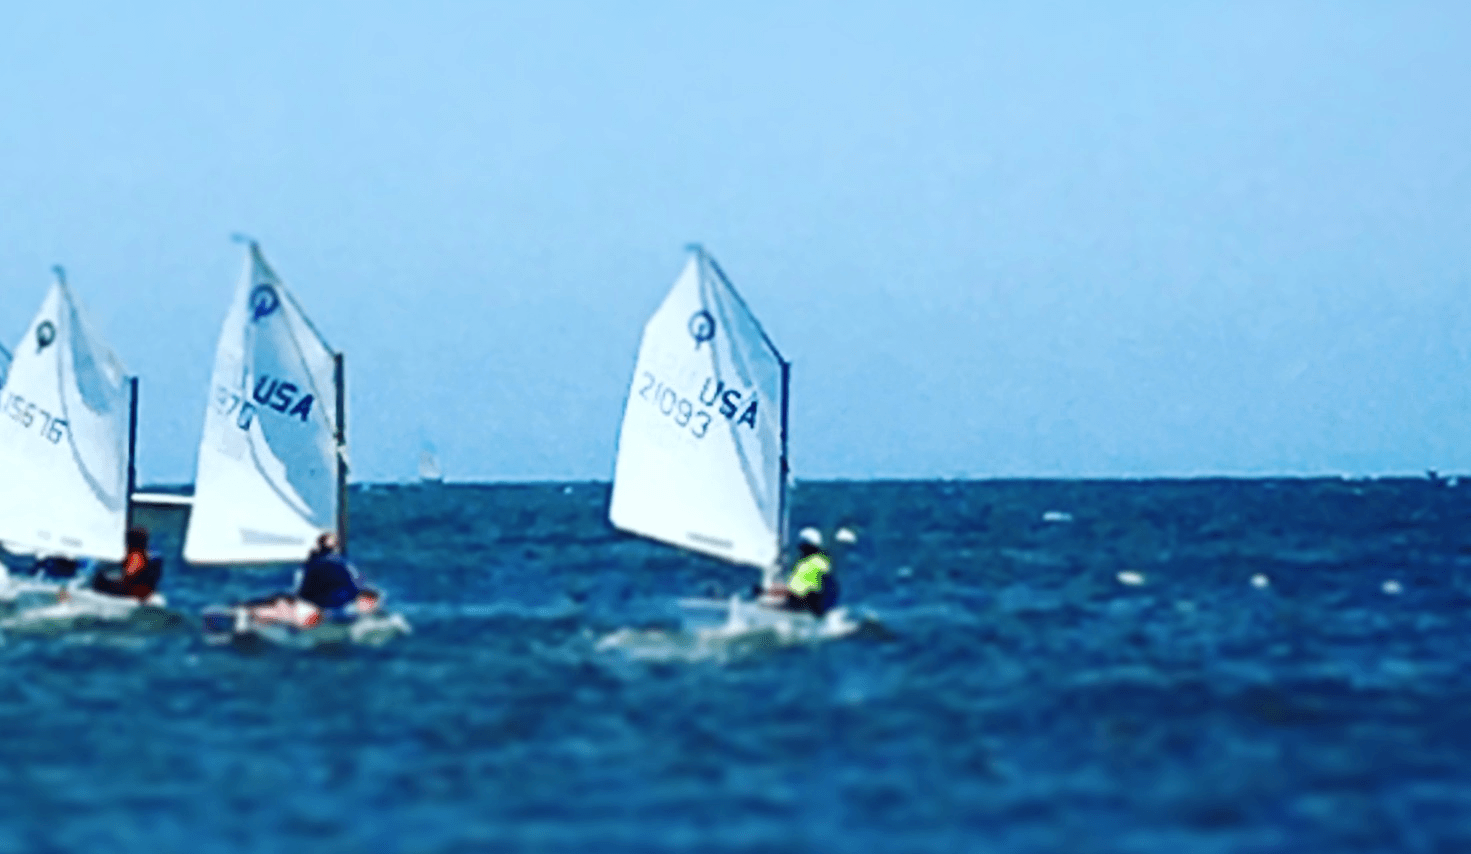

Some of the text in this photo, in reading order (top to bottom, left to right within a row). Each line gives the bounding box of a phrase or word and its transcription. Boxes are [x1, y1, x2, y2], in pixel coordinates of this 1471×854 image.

[253, 373, 314, 424] USA
[638, 369, 713, 440] 21093
[697, 376, 760, 430] USA
